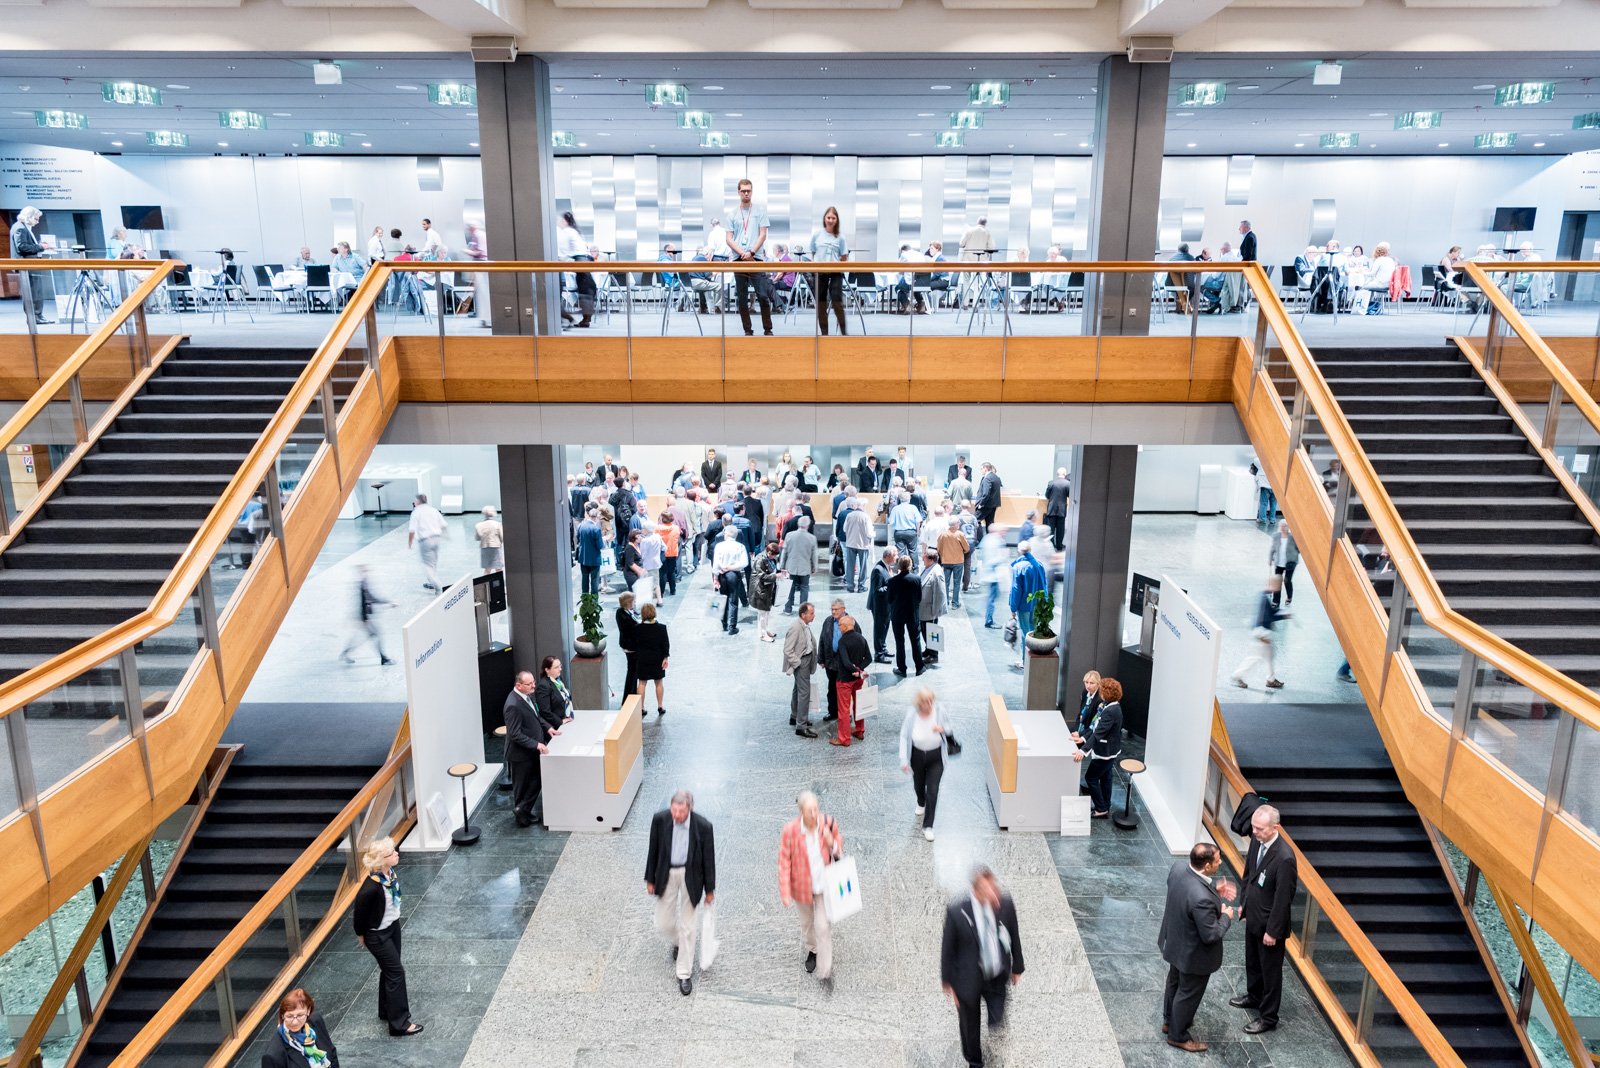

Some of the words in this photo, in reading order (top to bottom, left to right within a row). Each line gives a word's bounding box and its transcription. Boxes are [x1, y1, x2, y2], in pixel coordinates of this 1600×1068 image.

[602, 556, 610, 566] H
[444, 585, 469, 611] HEIDELBERG
[931, 632, 940, 643] H
[1161, 610, 1182, 641] Information
[1186, 610, 1211, 641] HEIDELBERG
[415, 638, 443, 669] Information
